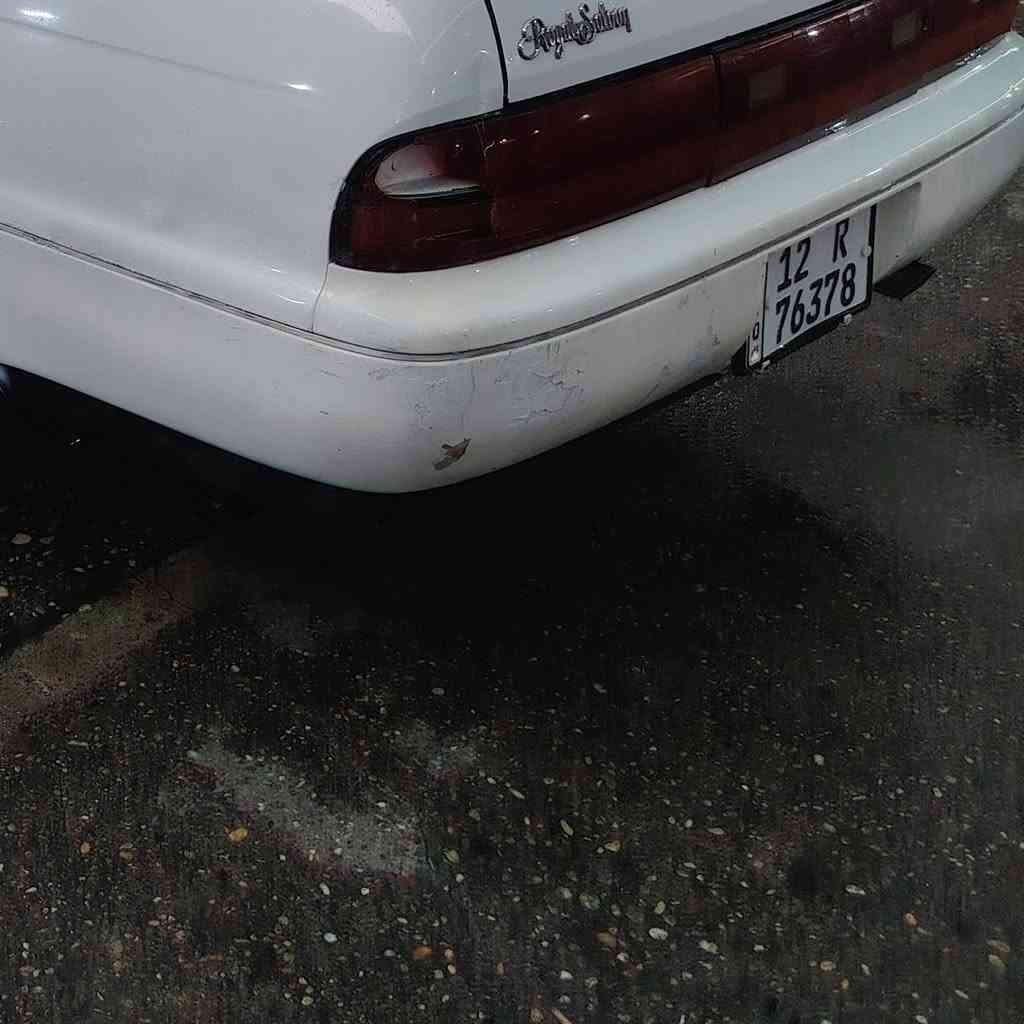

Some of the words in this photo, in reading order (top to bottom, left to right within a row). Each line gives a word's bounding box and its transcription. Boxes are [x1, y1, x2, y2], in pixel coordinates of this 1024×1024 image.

[777, 236, 812, 293] 12
[831, 217, 851, 264] R
[775, 262, 857, 345] 76378
